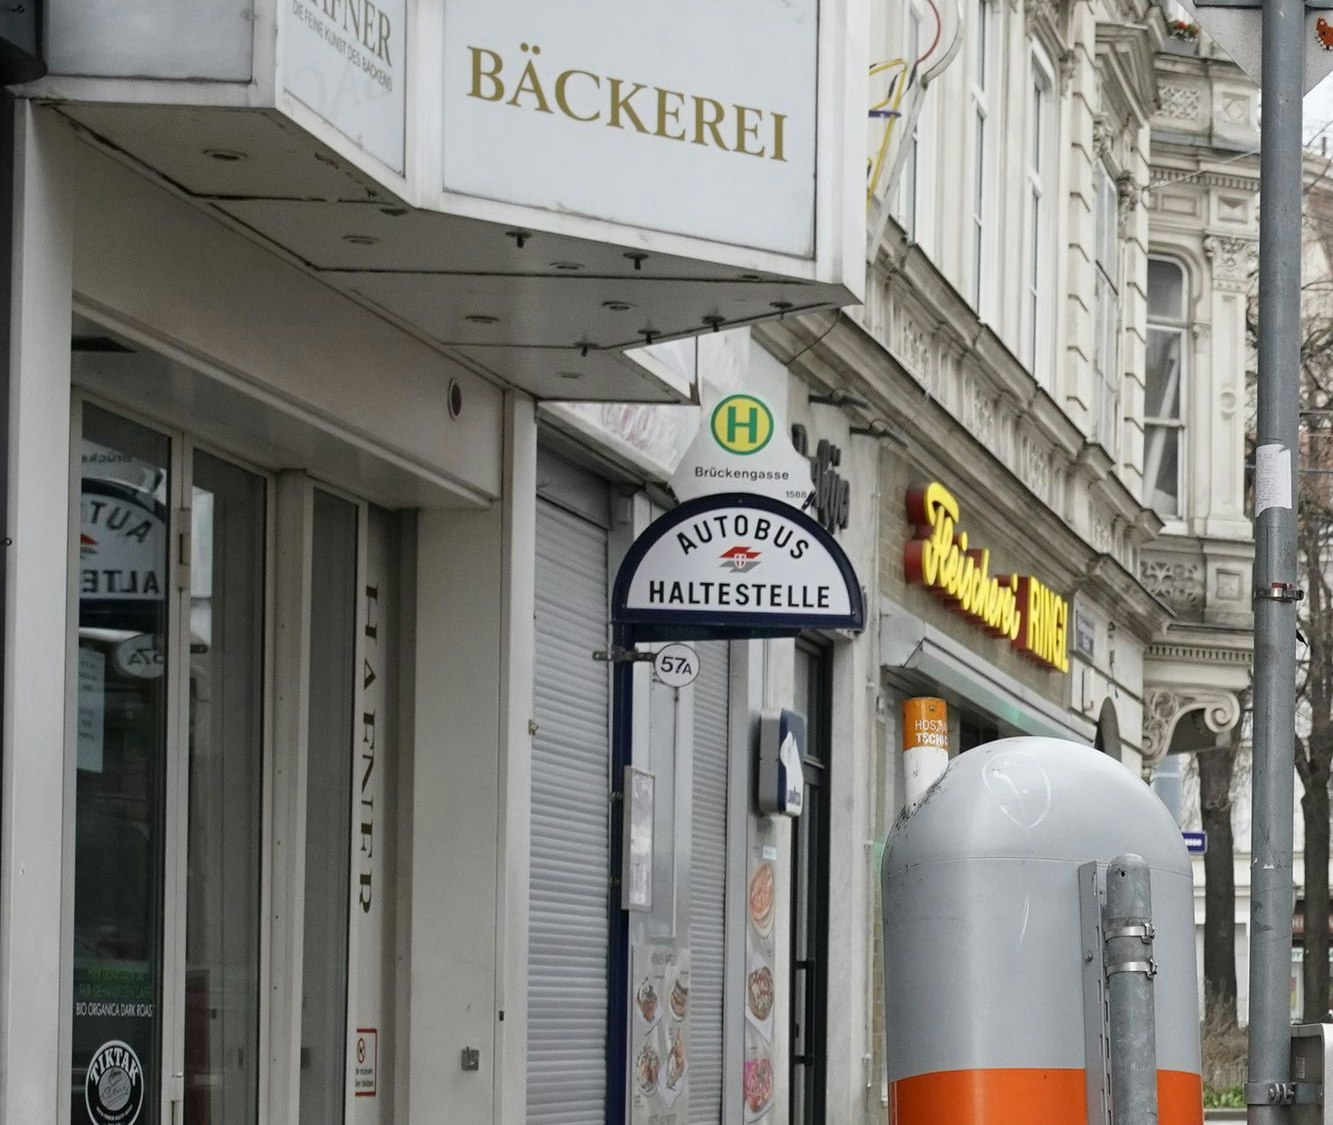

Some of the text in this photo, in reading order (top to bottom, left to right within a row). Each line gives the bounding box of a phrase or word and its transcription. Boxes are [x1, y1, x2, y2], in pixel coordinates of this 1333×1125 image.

[362, 55, 392, 92] BACKENS
[466, 43, 787, 162] BÄCKEREI
[694, 466, 789, 481] Brückengasse
[677, 515, 809, 559] AUTOBUS
[650, 581, 830, 608] HALTESTELLE
[1028, 575, 1069, 673] RINGL
[660, 656, 693, 675] 57A
[90, 1047, 139, 1087] TIKTAK
